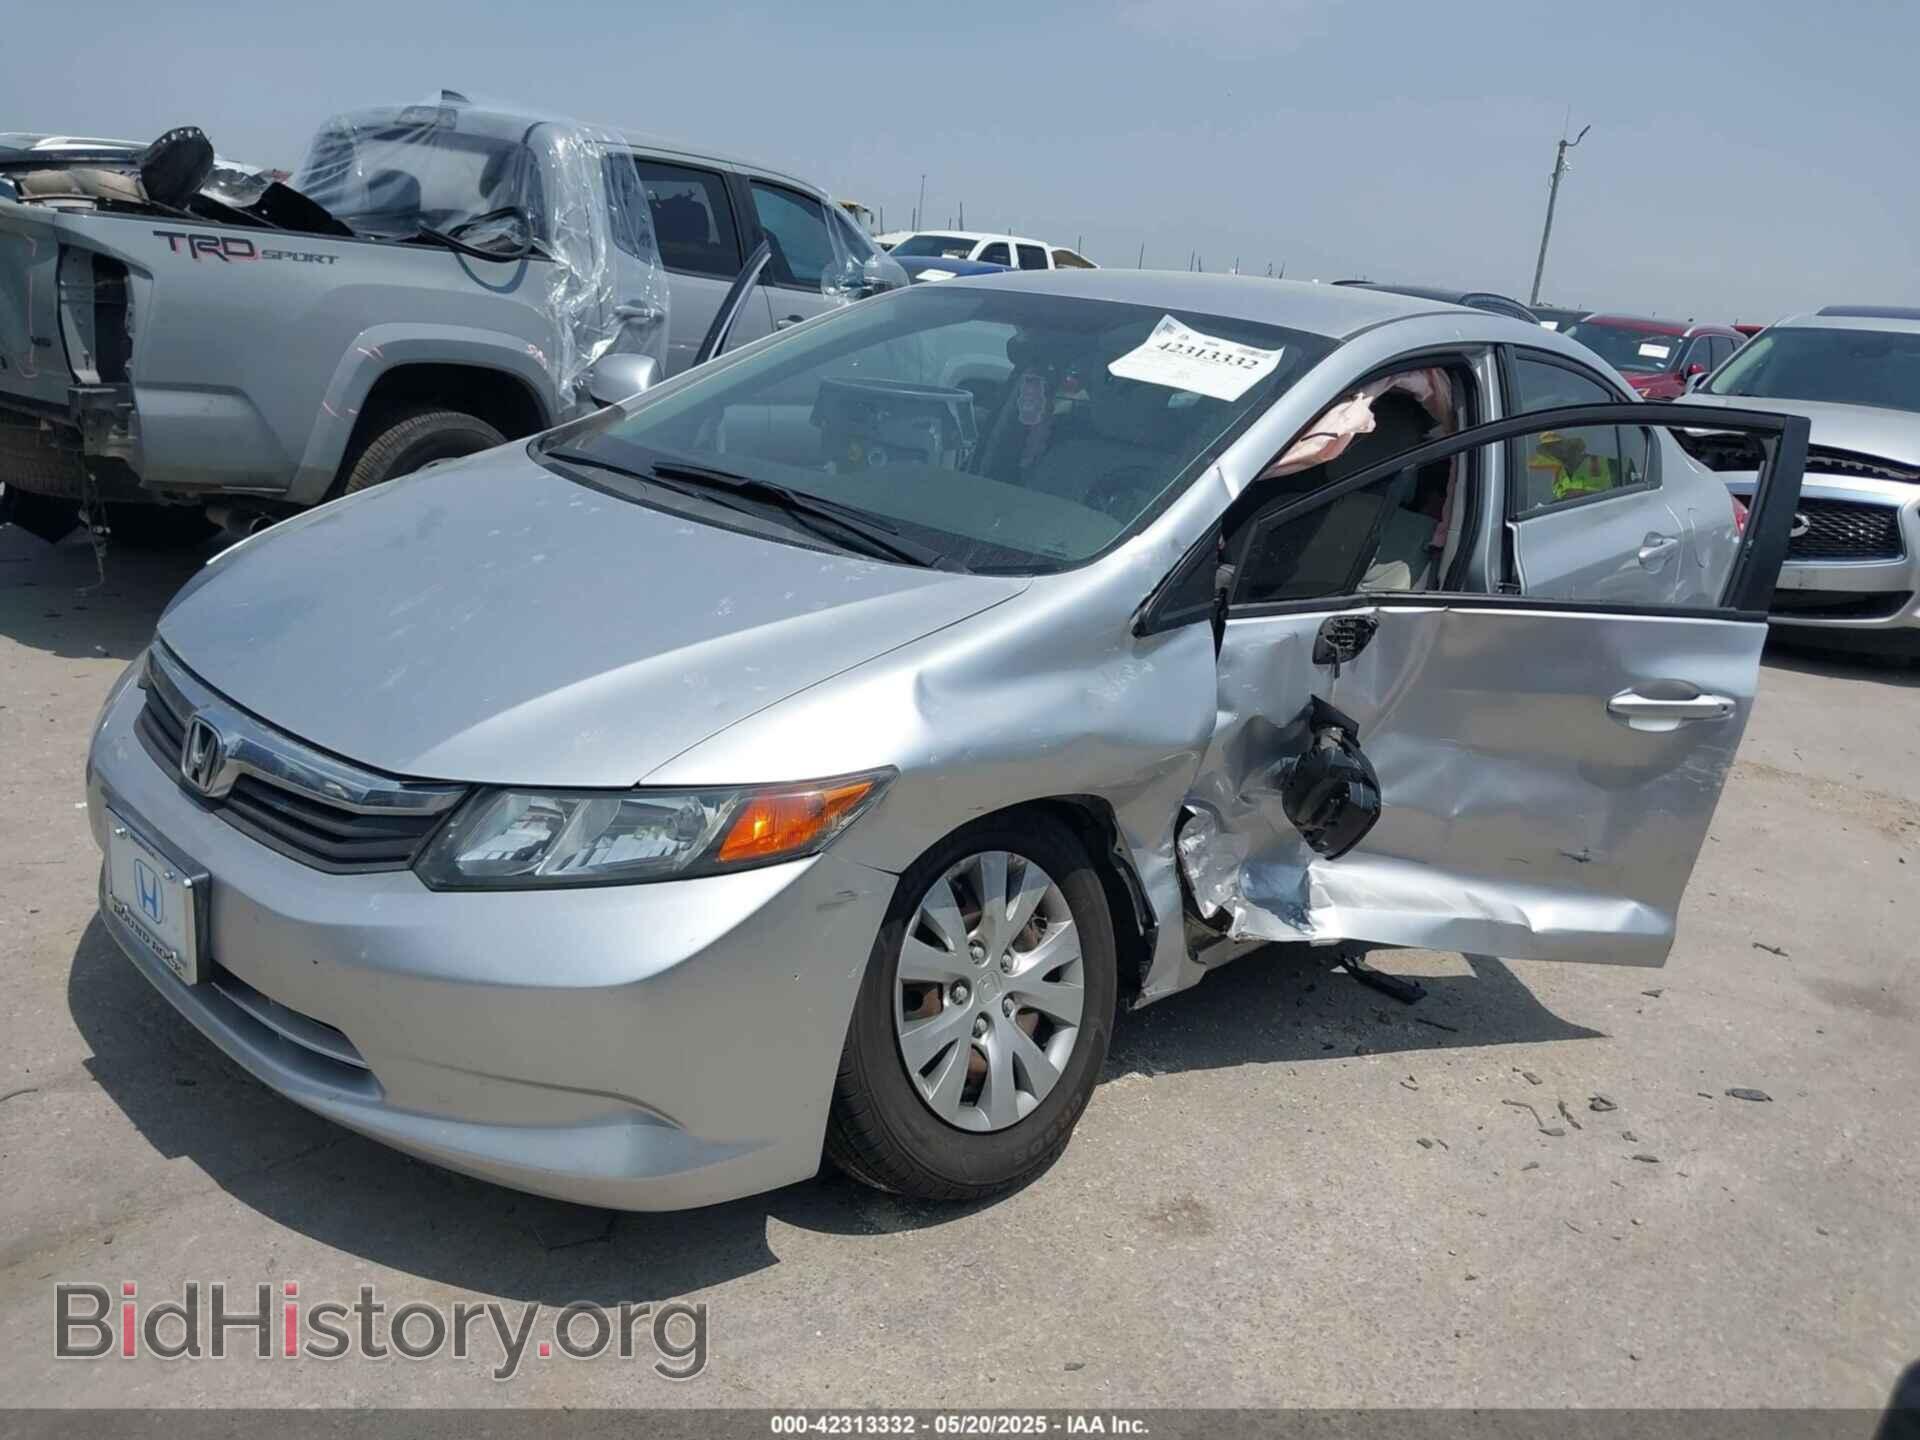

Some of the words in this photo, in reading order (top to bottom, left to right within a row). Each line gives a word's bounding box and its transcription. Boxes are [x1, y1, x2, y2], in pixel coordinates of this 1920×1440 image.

[152, 230, 258, 264] TRD
[261, 249, 340, 265] SPORT
[1155, 340, 1261, 370] 42313332
